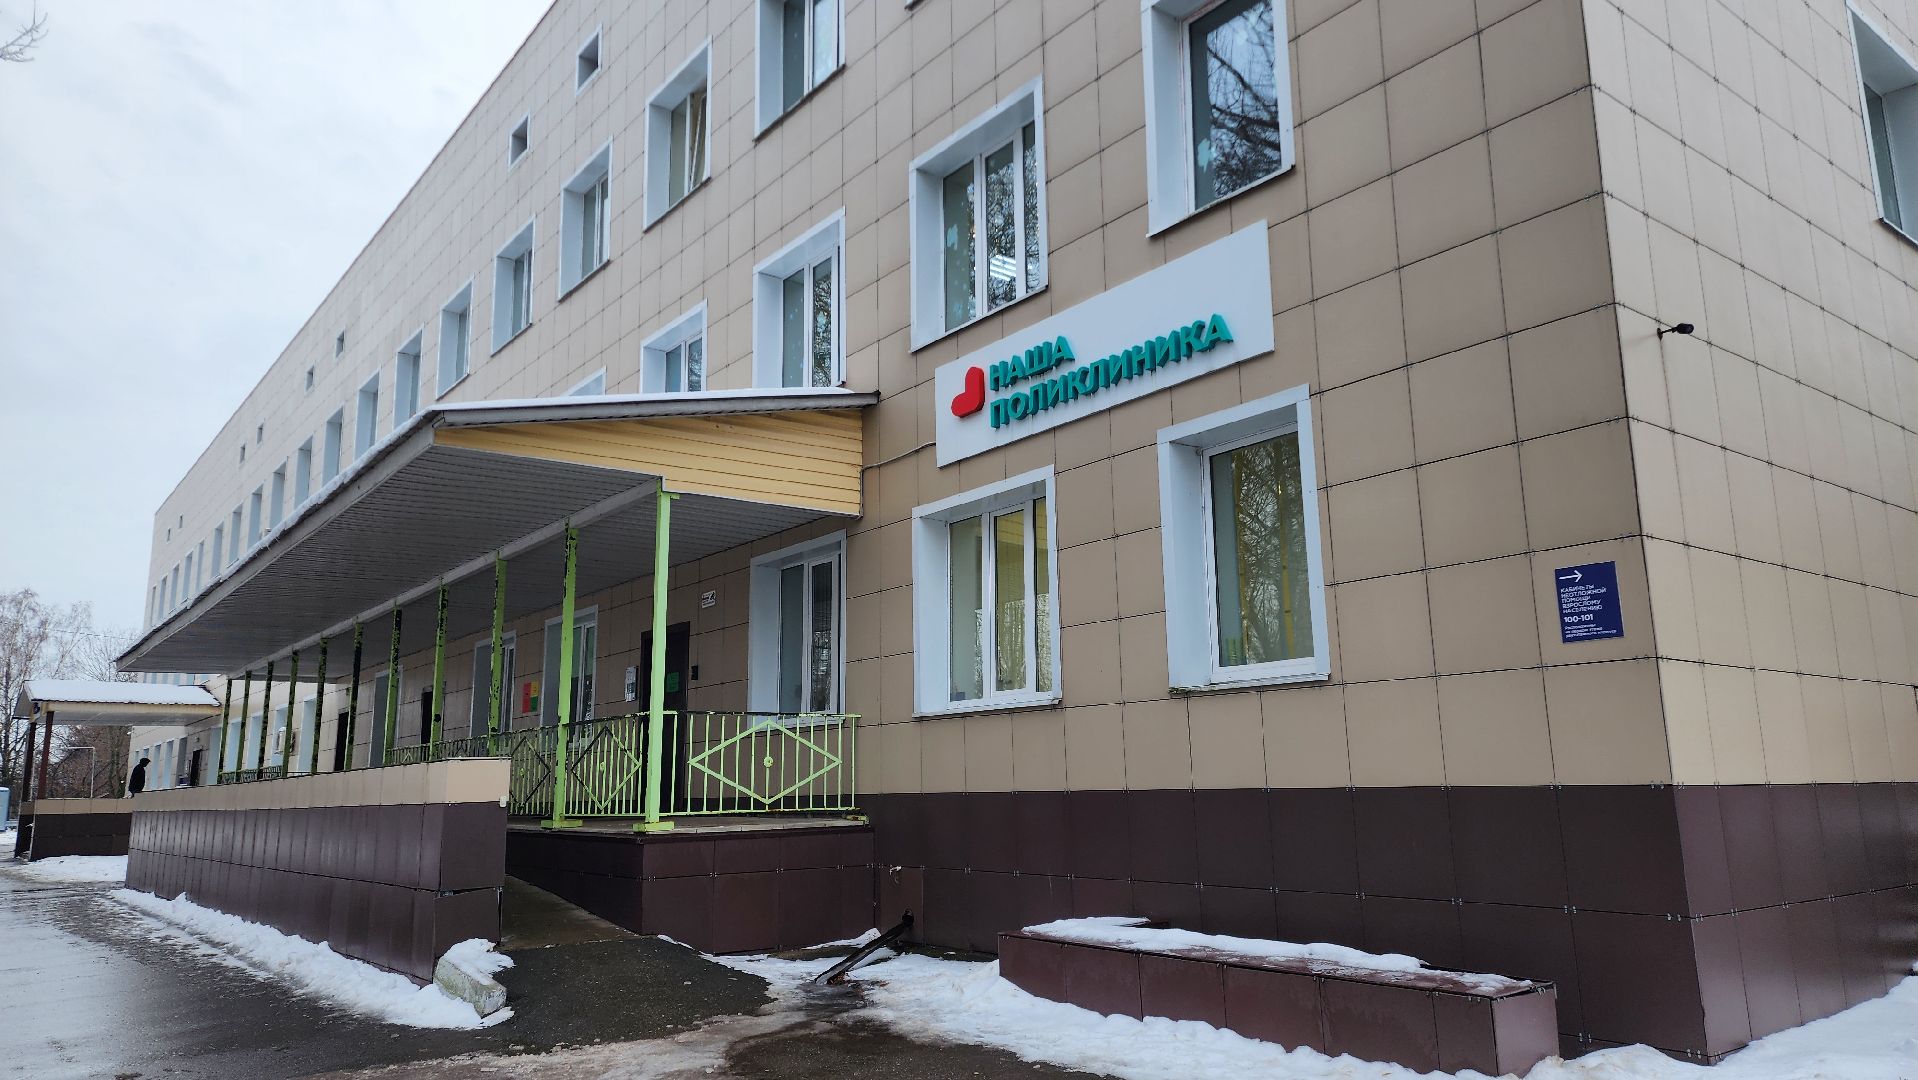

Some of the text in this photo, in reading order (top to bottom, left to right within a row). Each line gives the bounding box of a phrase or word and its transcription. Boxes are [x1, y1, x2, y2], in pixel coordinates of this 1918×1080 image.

[989, 335, 1075, 391] НАША
[990, 313, 1234, 428] ПОЛИКЛИНИКА
[1561, 584, 1595, 593] КАБИНЕТЫ
[1561, 587, 1607, 598] НЕОТЛОЖНОЙ
[1562, 599, 1601, 609] ВЗРОСЛОМУ
[1563, 605, 1603, 613] НАСЕЛЕНИЮ
[1564, 614, 1594, 622] 100-101
